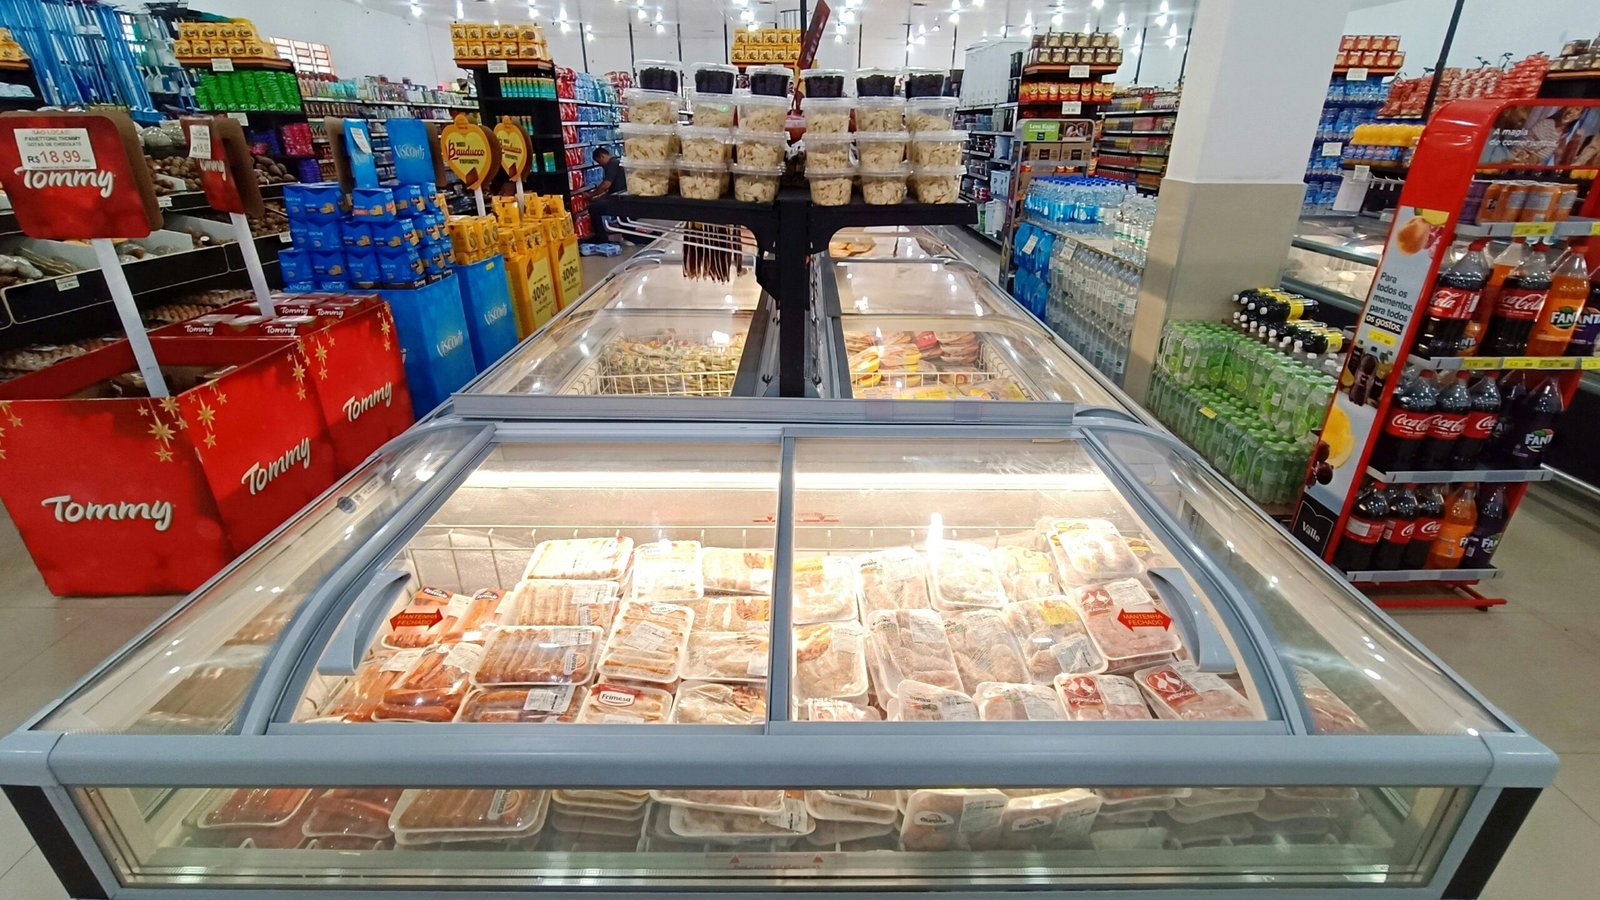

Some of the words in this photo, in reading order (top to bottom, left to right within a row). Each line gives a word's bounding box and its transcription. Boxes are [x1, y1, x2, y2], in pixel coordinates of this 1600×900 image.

[1502, 128, 1529, 137] magia
[14, 166, 113, 198] Tommy
[1381, 272, 1397, 284] Para
[1377, 283, 1397, 295] todos
[1398, 290, 1408, 298] os
[281, 306, 309, 316] Tommy
[316, 308, 344, 318] Tommy
[1369, 305, 1385, 315] para
[1387, 309, 1408, 321] todos
[1551, 313, 1576, 323] FAN
[184, 325, 214, 335] Tommy
[265, 325, 296, 335] Tommy
[342, 381, 392, 422] Tommy
[241, 438, 310, 495] Tommy
[41, 494, 173, 532] Tommy
[601, 693, 632, 702] Frimesa
